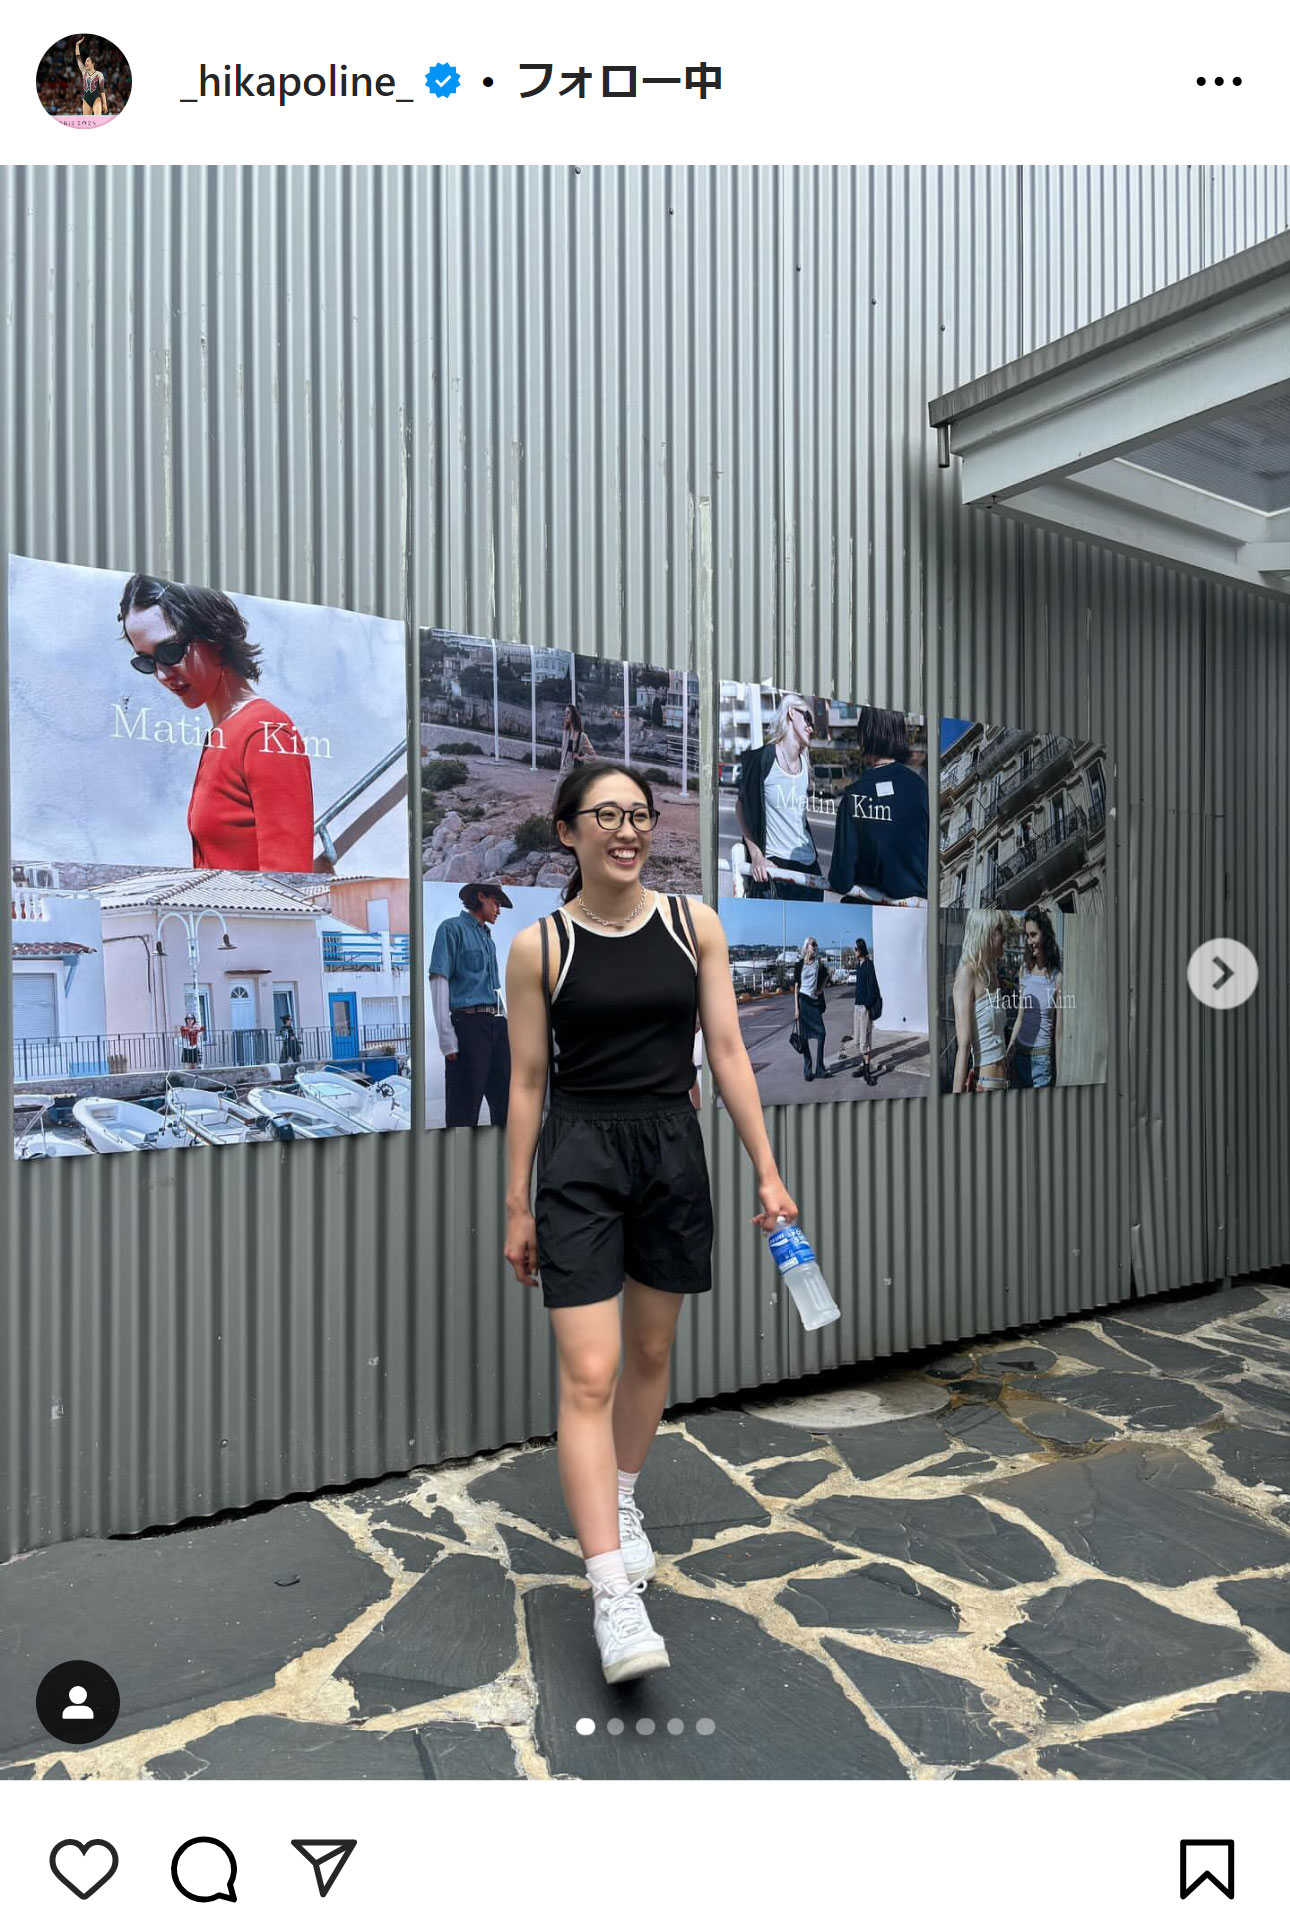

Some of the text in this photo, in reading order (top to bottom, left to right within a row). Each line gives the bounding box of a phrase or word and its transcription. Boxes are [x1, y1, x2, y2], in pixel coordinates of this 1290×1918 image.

[112, 703, 334, 759] Matin Kim
[775, 784, 893, 822] Matin Kim
[984, 987, 1077, 1009] Matin Kim
